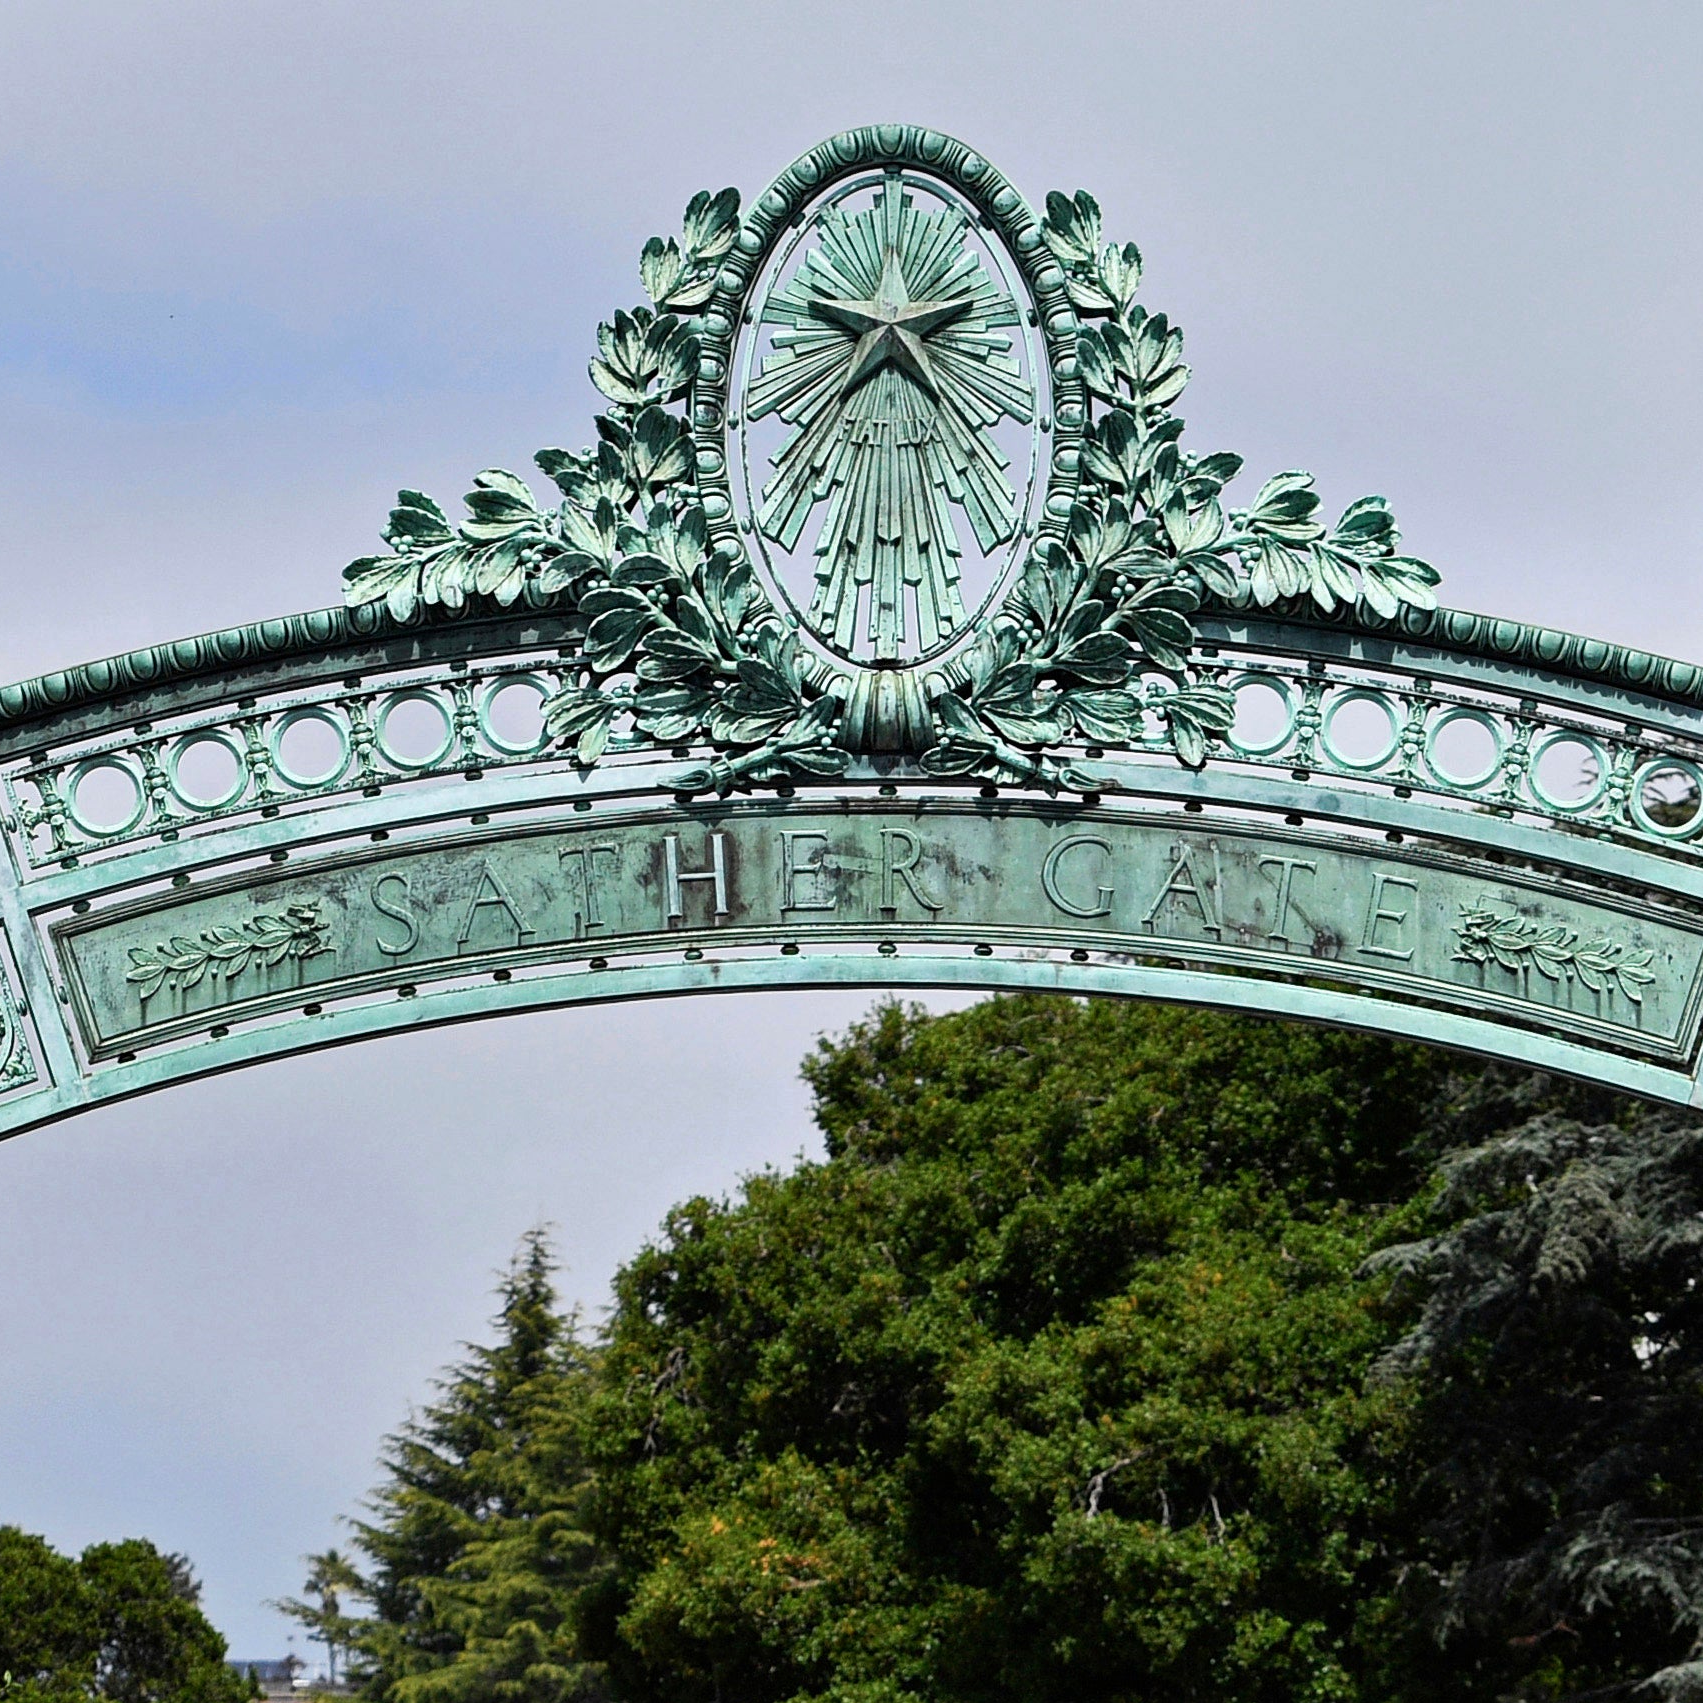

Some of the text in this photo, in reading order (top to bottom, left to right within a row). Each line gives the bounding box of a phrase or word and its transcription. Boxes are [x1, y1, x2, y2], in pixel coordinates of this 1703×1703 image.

[837, 415, 942, 448] FIAT LUX
[369, 826, 1420, 962] SATHER GATE
